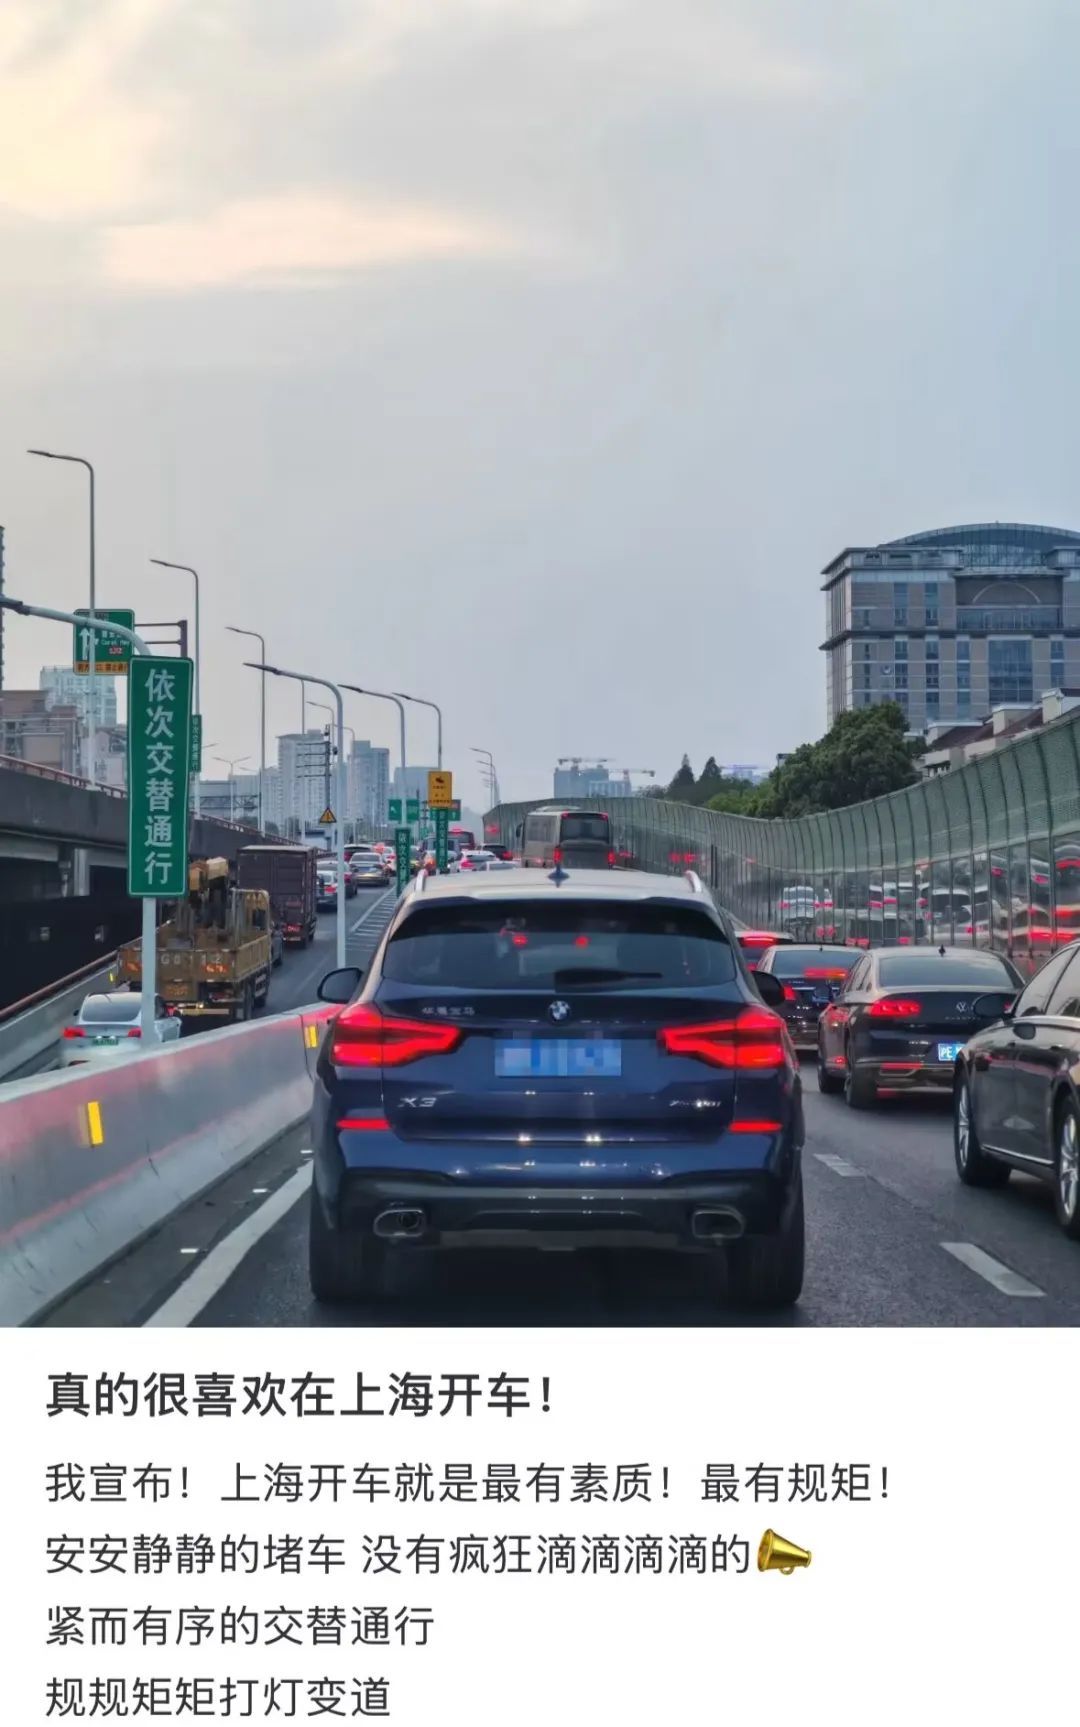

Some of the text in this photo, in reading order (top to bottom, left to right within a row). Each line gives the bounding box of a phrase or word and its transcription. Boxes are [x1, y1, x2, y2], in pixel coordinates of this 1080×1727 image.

[144, 668, 176, 885] 依次交替通行
[398, 1097, 437, 1108] X3
